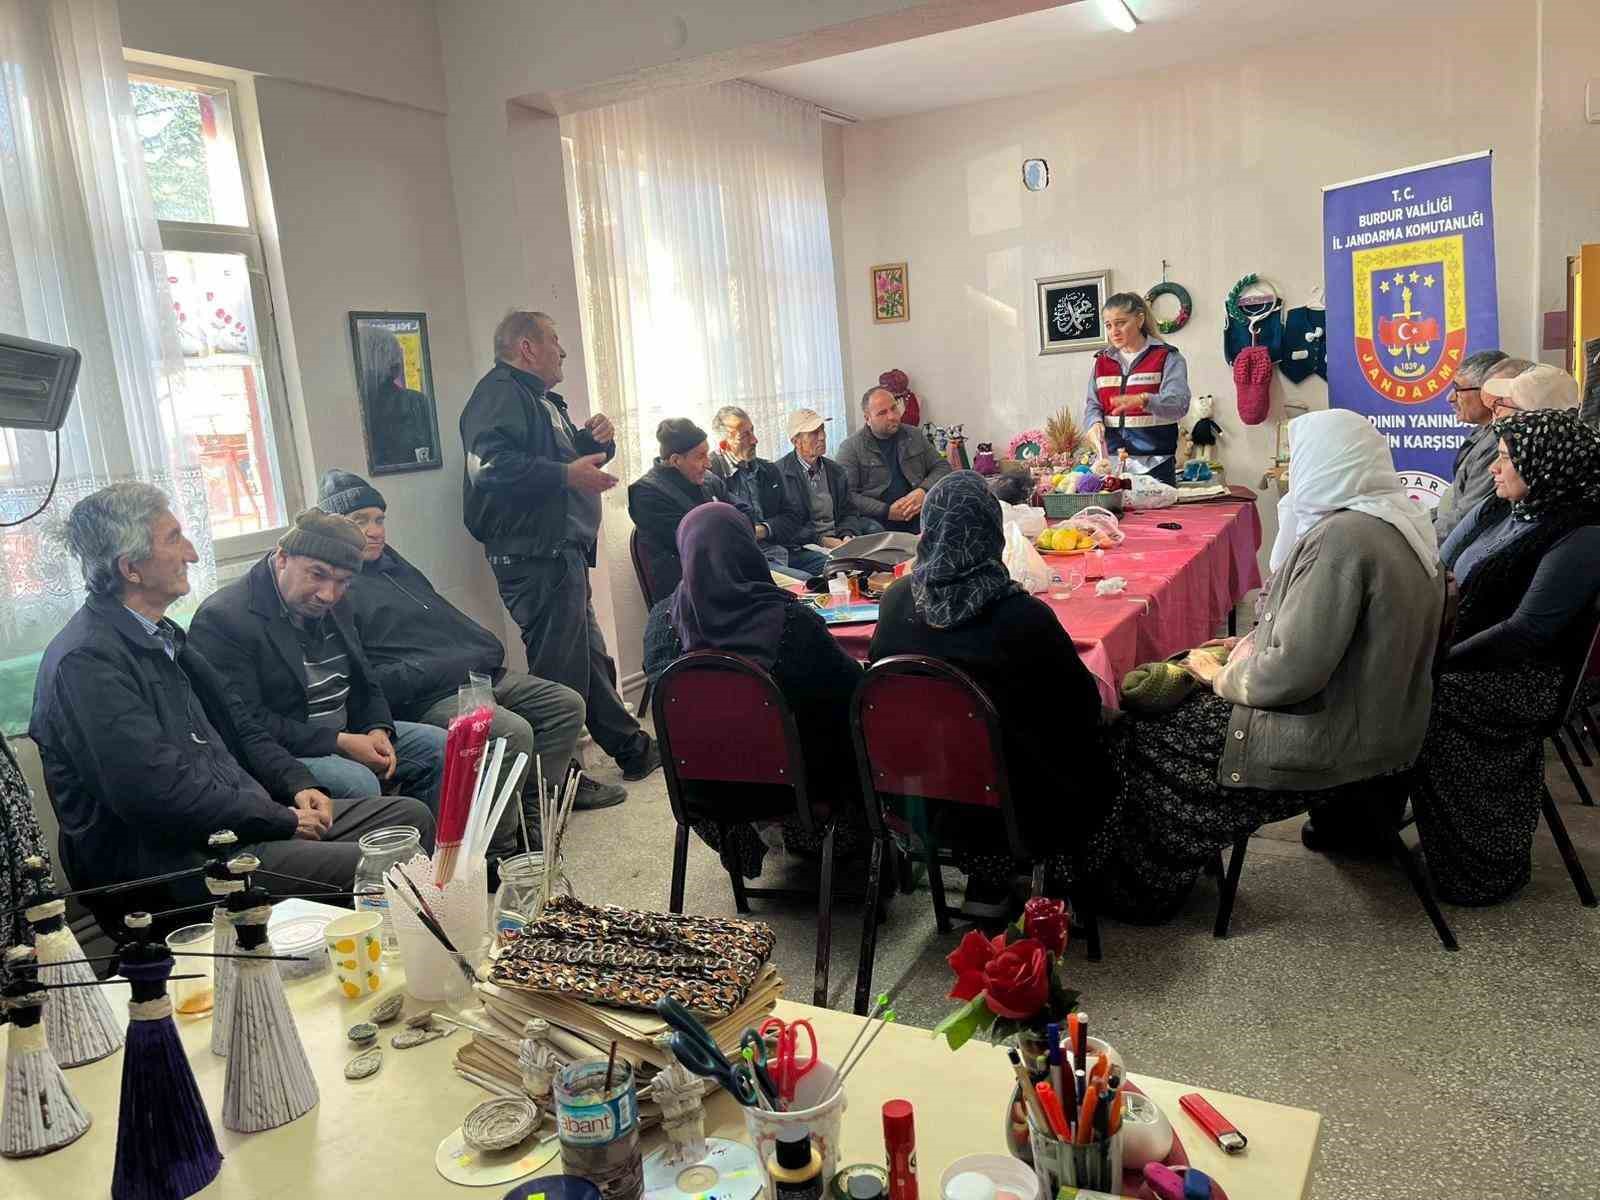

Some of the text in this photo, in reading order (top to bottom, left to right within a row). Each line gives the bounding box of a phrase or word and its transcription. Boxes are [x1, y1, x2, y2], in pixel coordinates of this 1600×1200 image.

[1332, 211, 1484, 250] İL JANDARMA KOMUTANLIĞI
[1359, 196, 1453, 227] BURDUR VALİLİĞİ
[1362, 348, 1461, 399] JANDARMA
